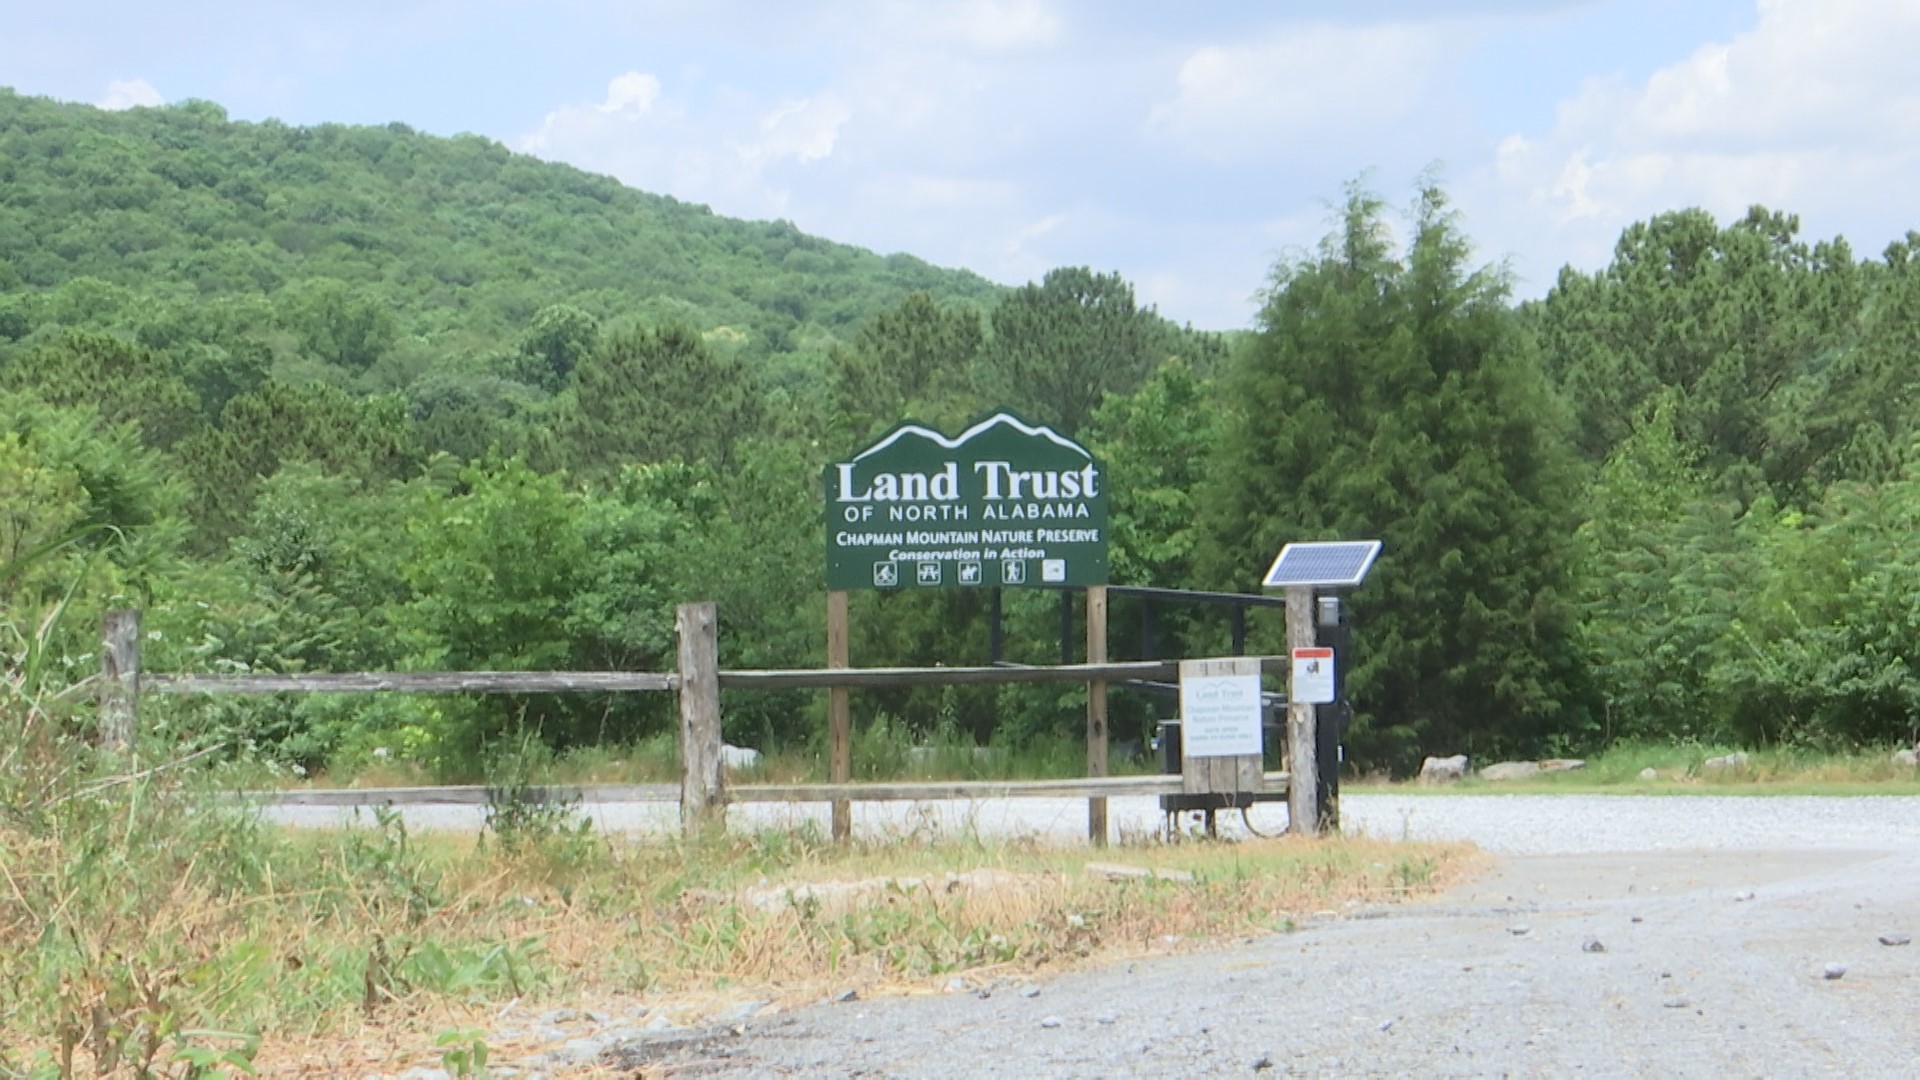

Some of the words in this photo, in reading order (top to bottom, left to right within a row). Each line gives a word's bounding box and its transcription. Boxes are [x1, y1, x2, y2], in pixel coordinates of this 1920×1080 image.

[835, 461, 960, 502] Land
[974, 461, 1099, 500] Trust
[844, 506, 874, 522] OF
[890, 505, 968, 521] NORTH
[983, 503, 1090, 520] ALABAMA
[836, 531, 903, 546] CHAPMAN
[906, 531, 979, 545] MOUNTAIN
[982, 530, 1033, 544] NATURE
[1037, 529, 1099, 542] PRESERVE
[889, 549, 980, 561] Conservation
[983, 548, 997, 560] in
[1000, 548, 1045, 559] Action
